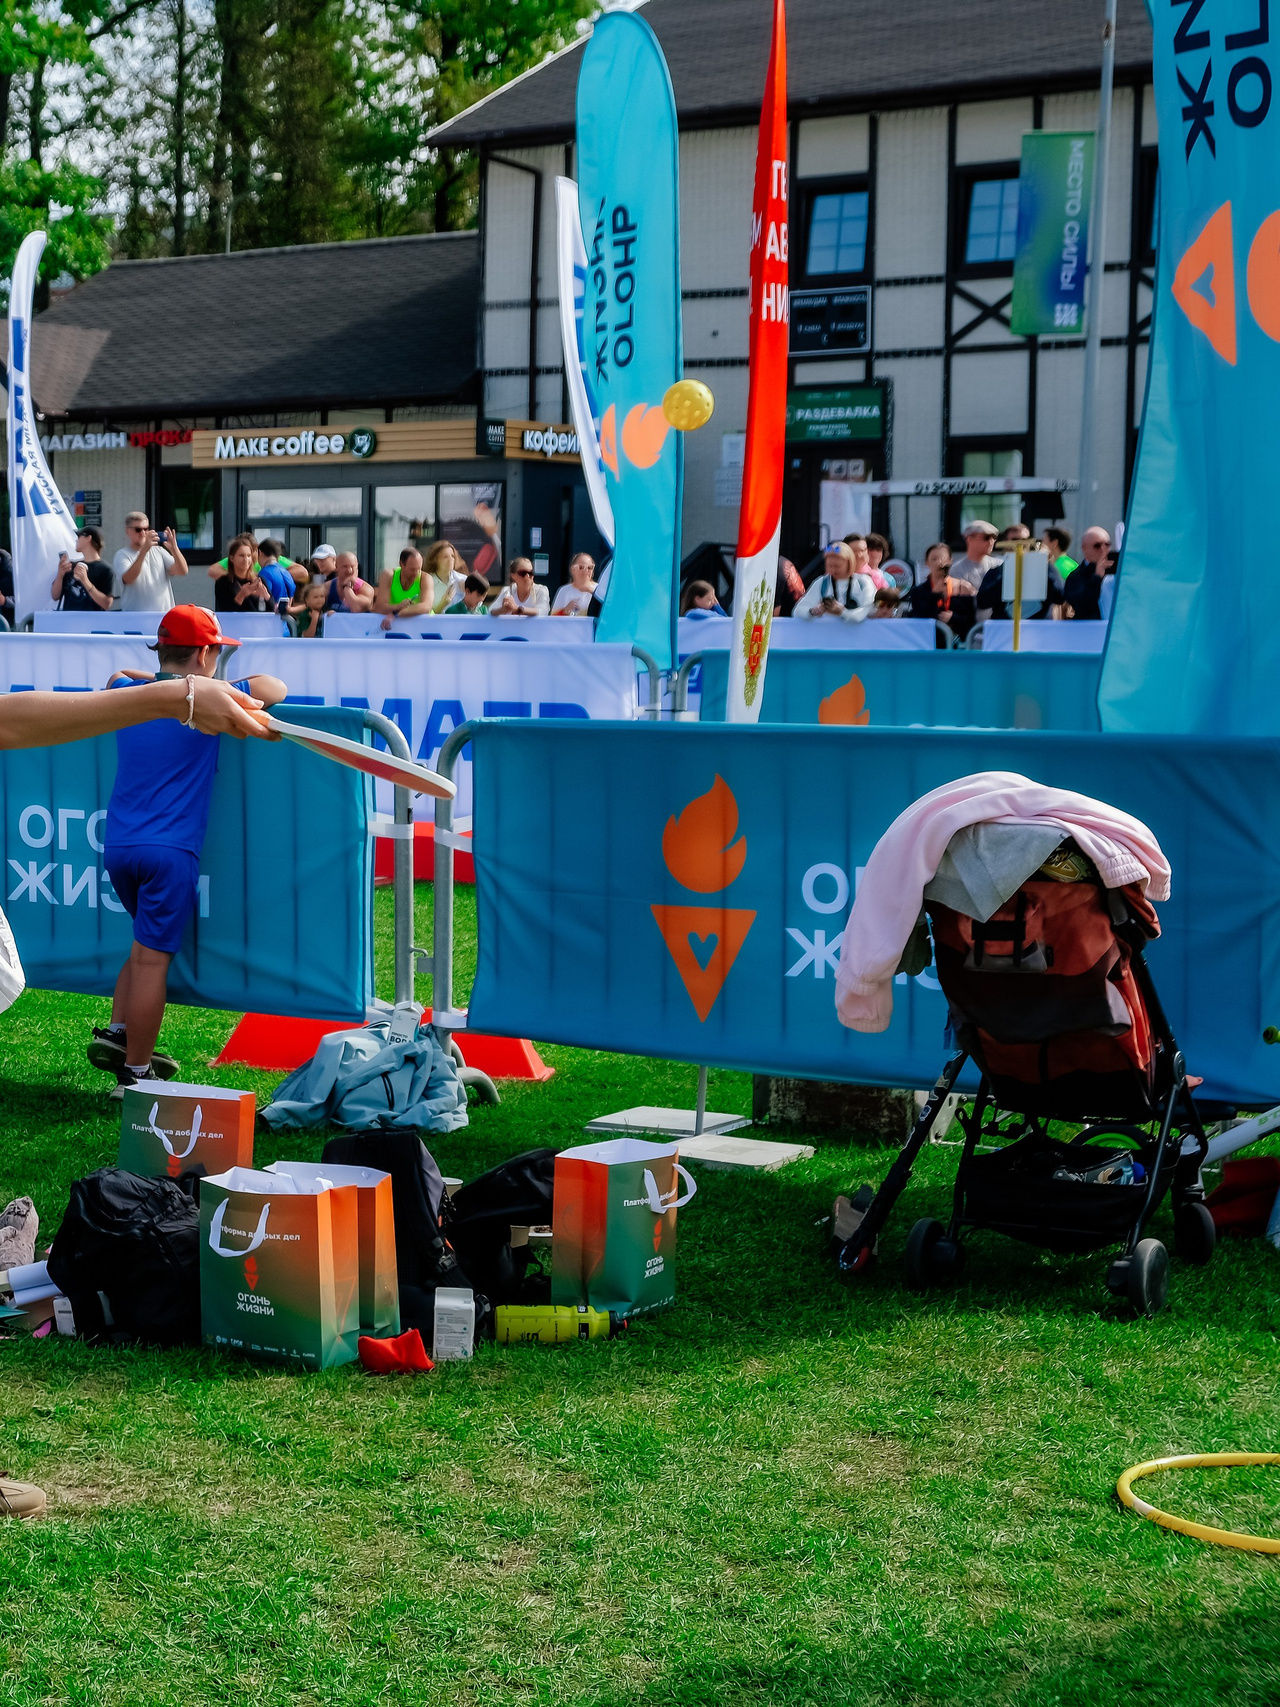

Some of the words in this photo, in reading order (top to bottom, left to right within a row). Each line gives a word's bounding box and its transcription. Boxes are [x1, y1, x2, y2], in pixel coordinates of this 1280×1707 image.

[1065, 139, 1086, 217] МЕСТО
[1060, 220, 1080, 291] СИЛЫ
[796, 405, 880, 421] РАЗДЕВАЛКА
[488, 425, 504, 435] MAKE
[130, 430, 193, 448] ПРОКА
[214, 436, 269, 460] MAKE
[270, 431, 345, 456] coffee
[7, 858, 210, 918] ЖИЗИ
[391, 1031, 408, 1039] ПРОСТО
[220, 1225, 247, 1237] тформа
[646, 1255, 664, 1269] ОГОНЬ
[644, 1264, 665, 1279] ЖИЗНИ
[237, 1292, 271, 1306] ОГОНЬ
[236, 1301, 275, 1317] ЖИЗНИ
